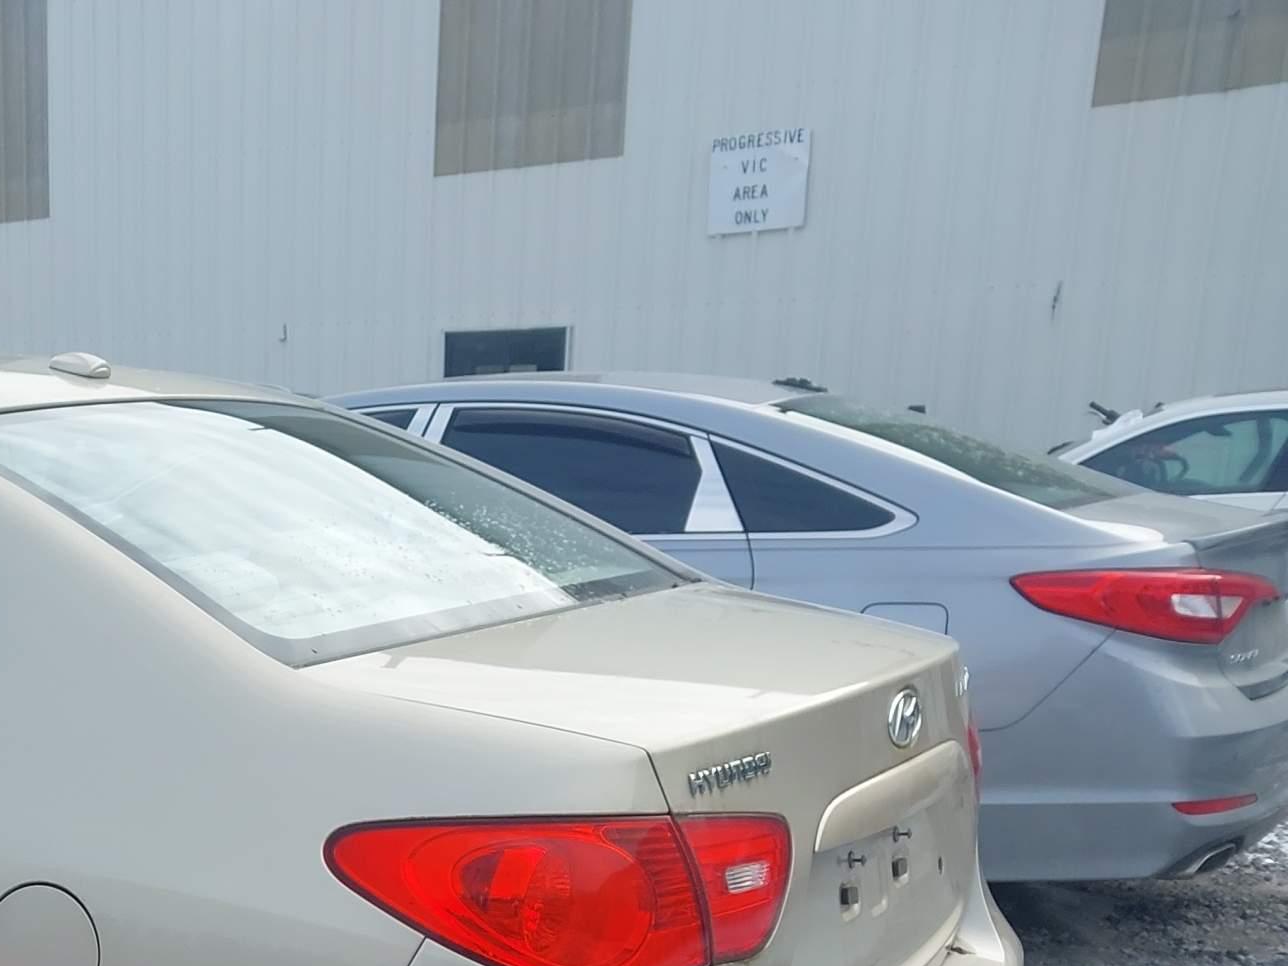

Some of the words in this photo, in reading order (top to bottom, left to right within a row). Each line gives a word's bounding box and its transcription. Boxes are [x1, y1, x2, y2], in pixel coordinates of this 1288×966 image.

[712, 128, 805, 152] PROGRESSIVE
[741, 158, 768, 174] VIC
[733, 184, 768, 201] AREA
[735, 208, 769, 224] ONLY
